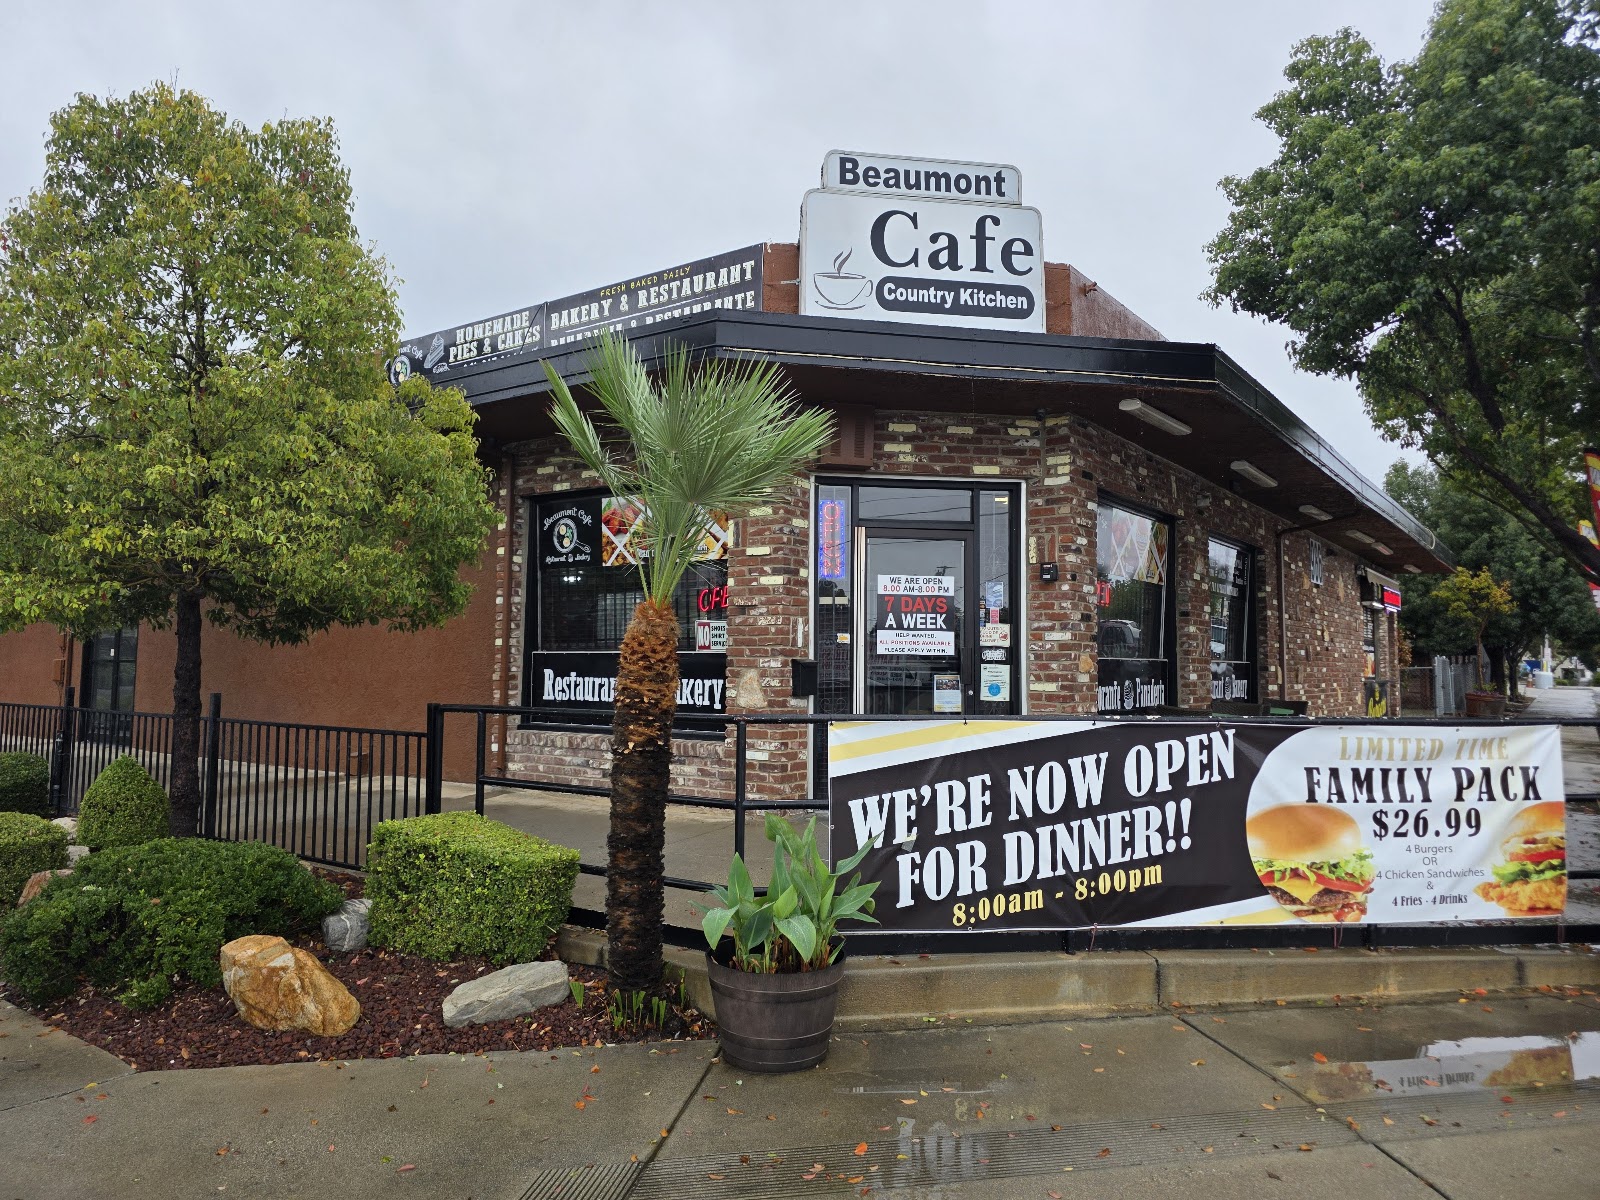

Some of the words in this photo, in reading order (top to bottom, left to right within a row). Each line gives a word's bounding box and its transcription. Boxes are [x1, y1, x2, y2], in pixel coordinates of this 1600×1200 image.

[839, 156, 1006, 198] Beaumont
[870, 209, 1034, 276] Cafe
[551, 299, 613, 331] BAKERY
[619, 294, 629, 313] &
[638, 260, 755, 309] RESTAURANT
[600, 284, 626, 297] FRESH
[630, 276, 658, 290] BAKED
[664, 265, 691, 280] DAILY
[883, 282, 954, 308] Country
[959, 288, 1028, 309] Kitchen
[456, 311, 530, 345] HOMEMADE
[449, 341, 478, 363] PIES
[483, 337, 492, 354] &
[498, 325, 541, 351] CAKES
[578, 510, 592, 527] Cafe
[904, 577, 920, 585] ARE
[884, 596, 895, 612] 7
[901, 596, 948, 613] DAYS
[884, 612, 897, 629] A
[901, 613, 947, 629] WEEK
[697, 625, 710, 646] NO
[542, 669, 617, 702] Restauran
[1339, 736, 1444, 762] LIMITED
[1454, 736, 1510, 761] TIME
[848, 773, 993, 851] WE'RE
[1007, 751, 1109, 822] NOW
[1123, 728, 1237, 798] OPEN
[1304, 766, 1433, 804] FAMILY
[1451, 765, 1543, 802] PACK
[1372, 807, 1482, 841] $26.99
[895, 839, 988, 909] FOR
[1002, 797, 1193, 887] DINNER!!
[1405, 844, 1412, 853] 4
[1414, 844, 1453, 856] Burgers
[1422, 856, 1438, 866] OR
[1376, 870, 1383, 880] 4
[1385, 869, 1424, 881] Chicken
[1427, 867, 1485, 880] Sandwiches
[1426, 881, 1434, 890] &
[952, 888, 1044, 928] 8:00am
[1075, 864, 1163, 902] 8:00pm
[1392, 896, 1399, 907] 4
[1400, 895, 1423, 907] Fries
[1431, 895, 1438, 906] 4
[1438, 894, 1468, 906] Drinks
